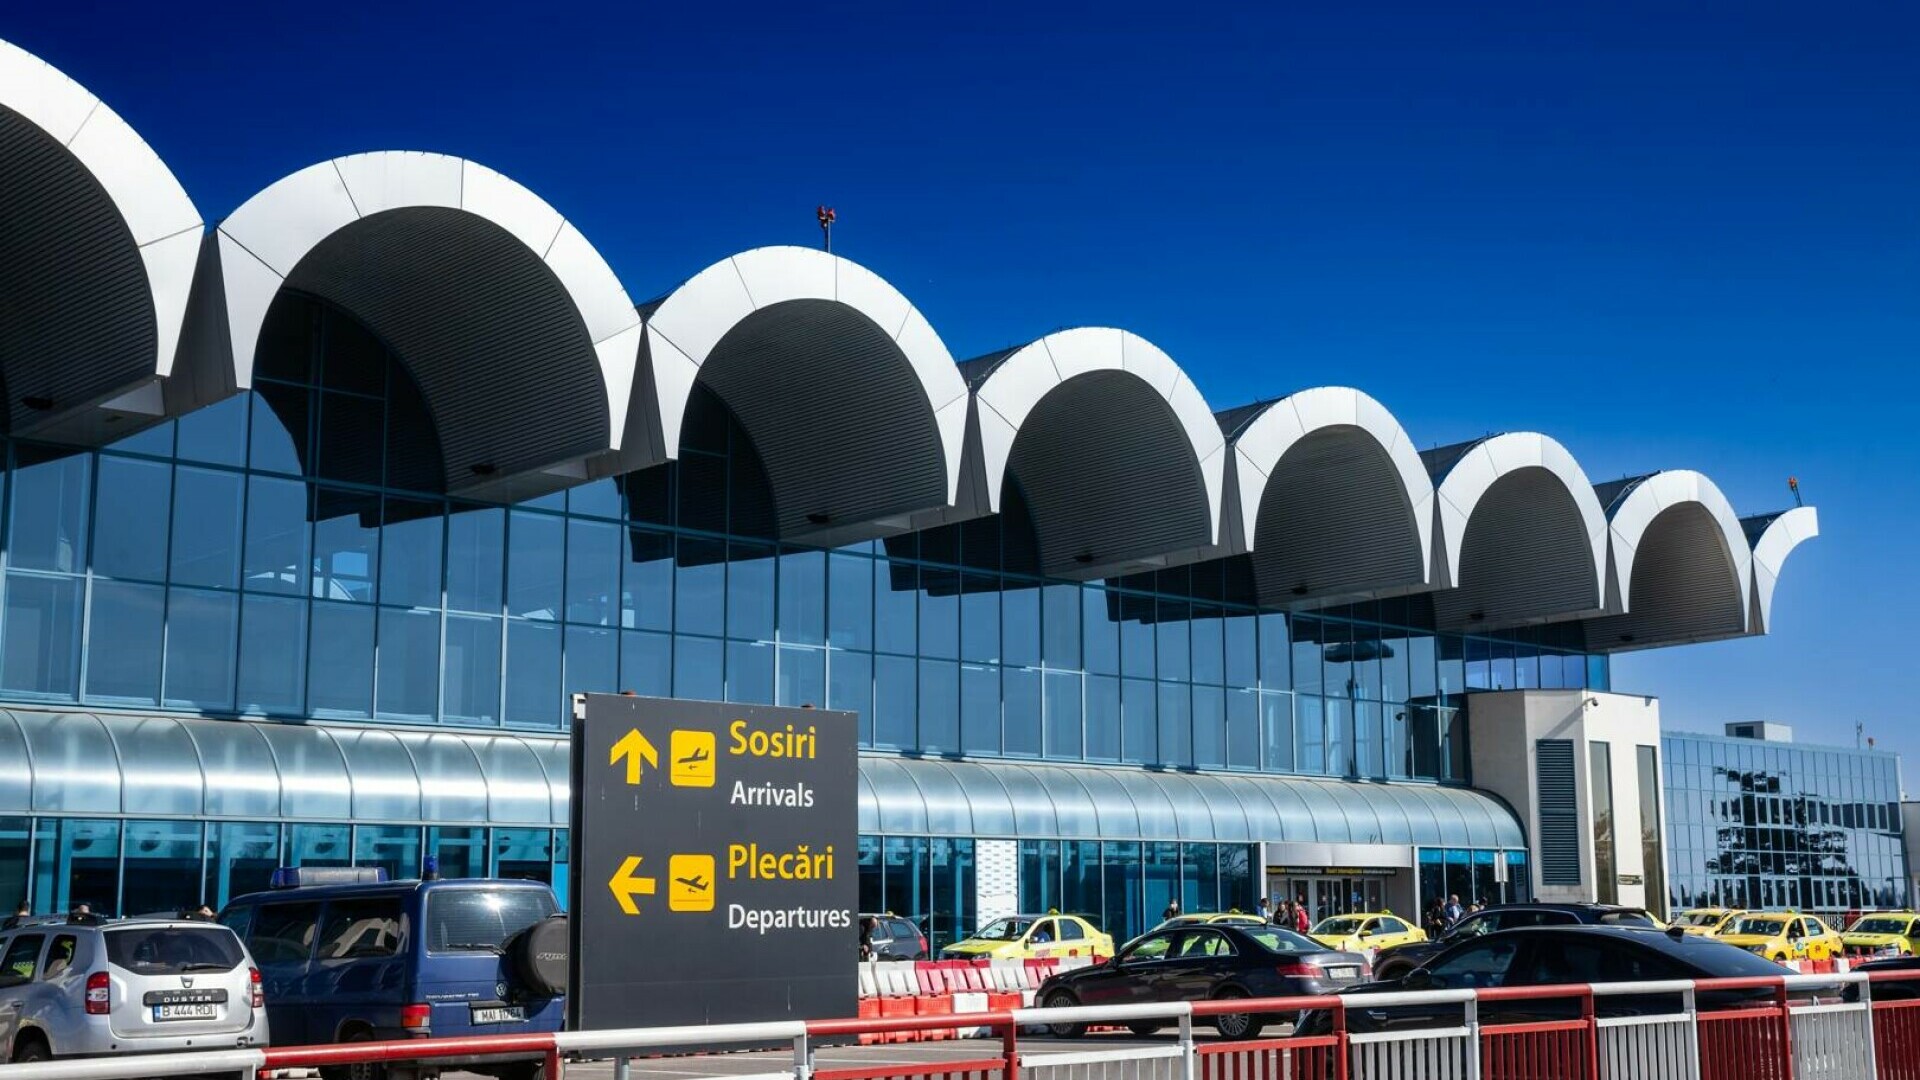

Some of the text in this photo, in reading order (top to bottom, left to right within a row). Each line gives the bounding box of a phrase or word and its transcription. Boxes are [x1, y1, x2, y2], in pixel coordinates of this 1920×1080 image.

[729, 719, 816, 759] Sosiri
[730, 780, 814, 808] Arrivals
[728, 842, 833, 880] Plecări
[728, 903, 851, 935] Departures
[162, 1005, 170, 1017] B
[174, 1005, 193, 1015] 444
